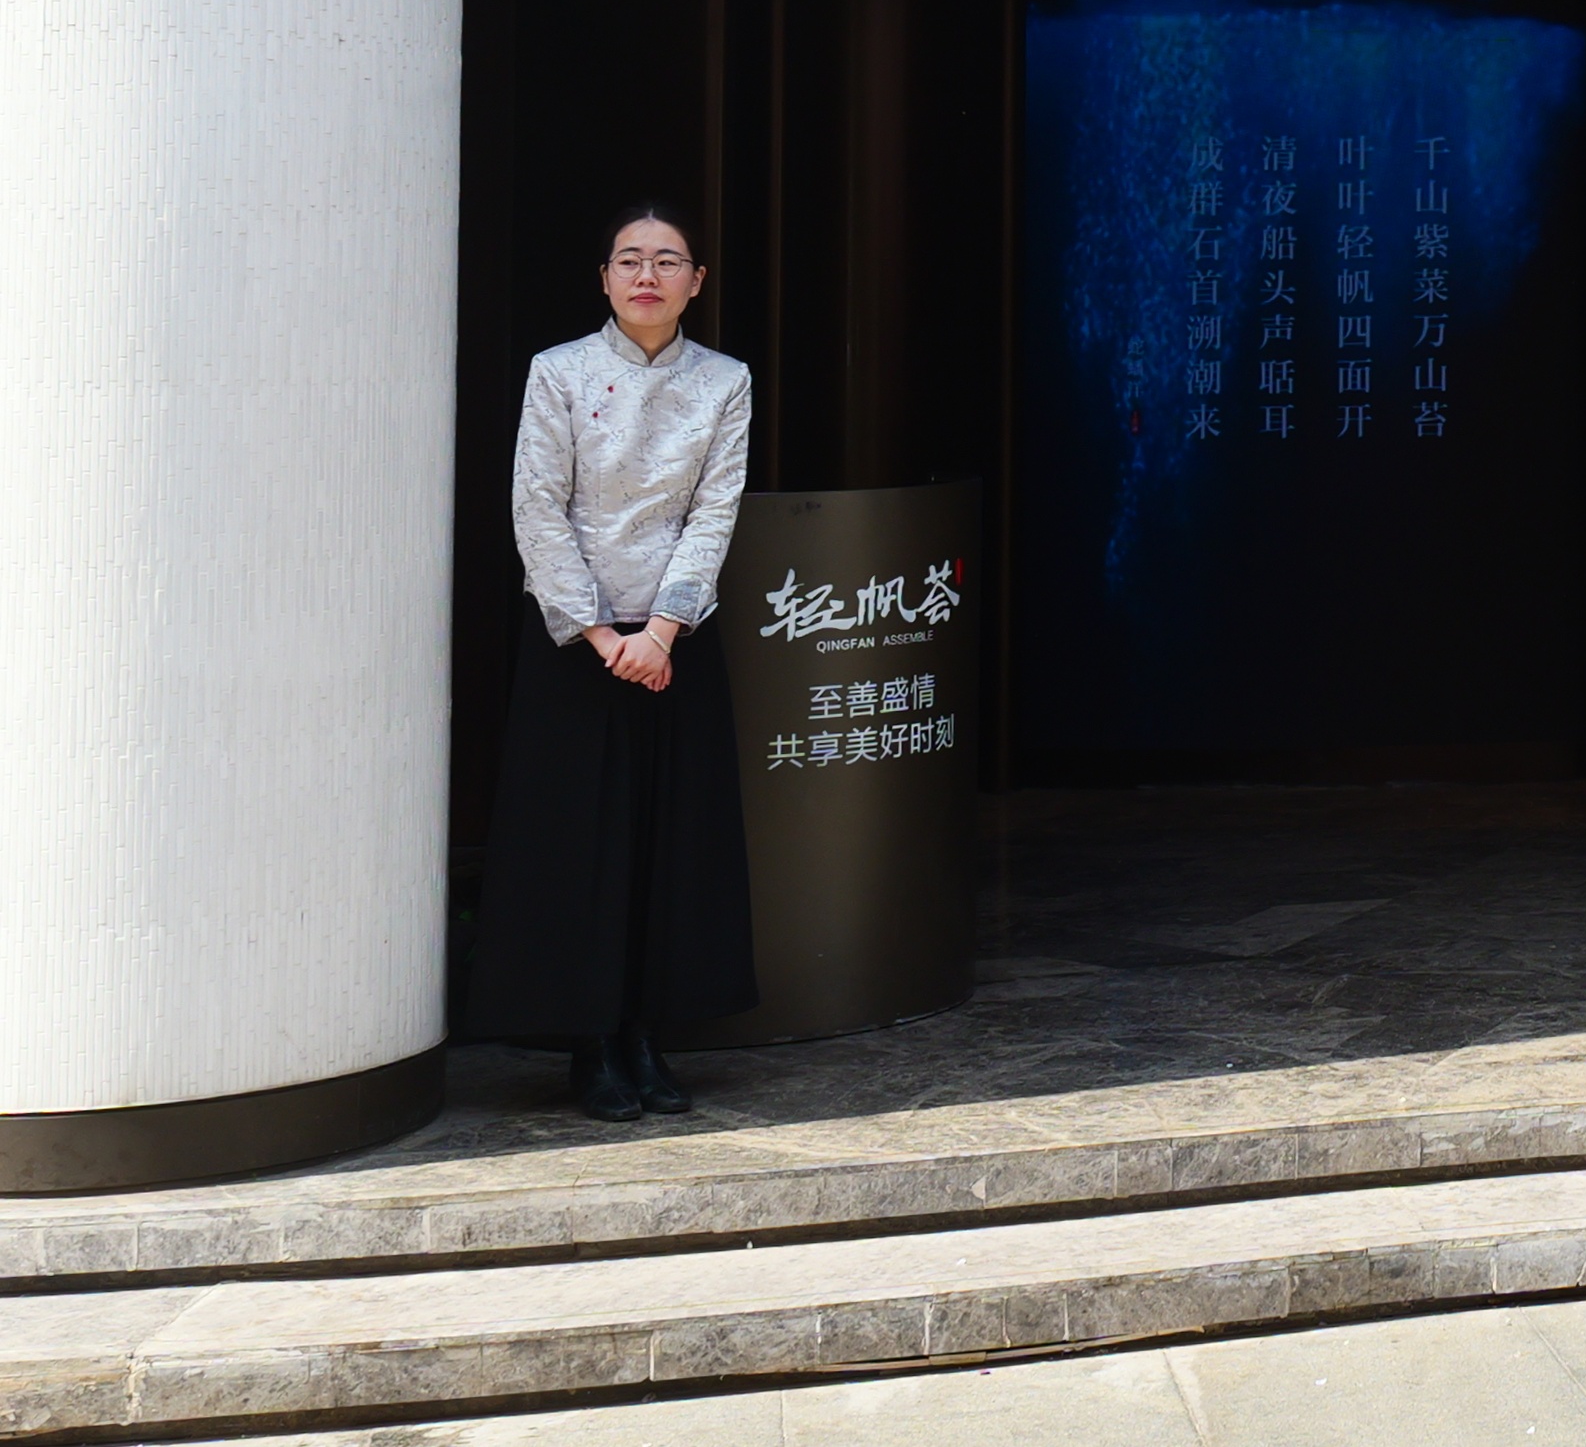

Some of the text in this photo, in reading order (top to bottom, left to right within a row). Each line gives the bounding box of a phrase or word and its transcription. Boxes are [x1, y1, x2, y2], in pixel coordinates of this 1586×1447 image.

[1336, 136, 1374, 439] 叶叶轻帆四面开
[1413, 136, 1450, 438] 千山紫菜万山苔
[759, 560, 960, 642] 轻帆荟
[816, 630, 934, 654] QINGFAN ASSEMBLE
[807, 673, 935, 721] 至善盛情
[767, 713, 955, 771] 共享美好时刻
